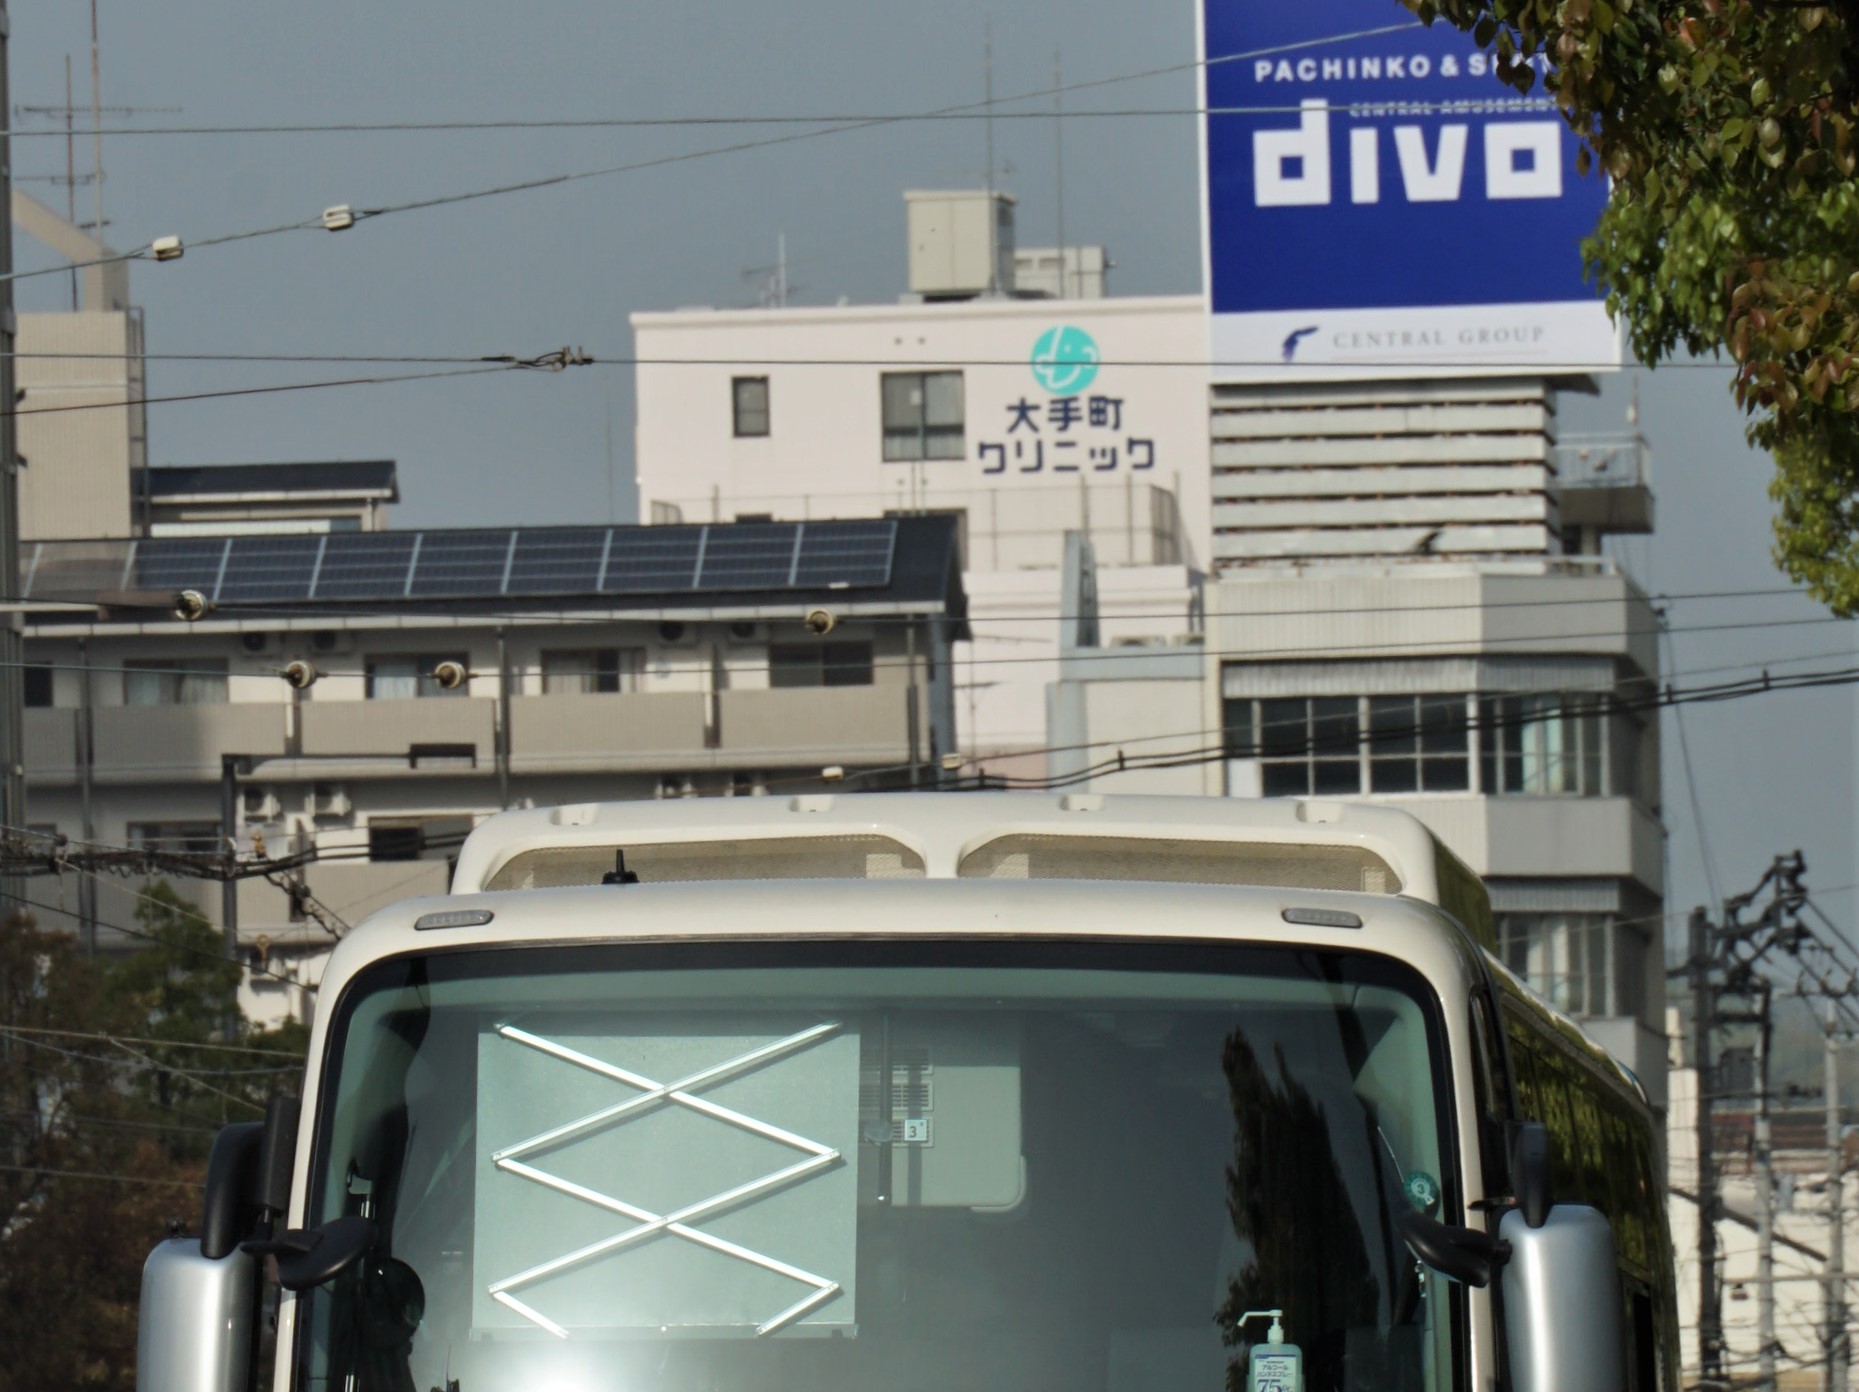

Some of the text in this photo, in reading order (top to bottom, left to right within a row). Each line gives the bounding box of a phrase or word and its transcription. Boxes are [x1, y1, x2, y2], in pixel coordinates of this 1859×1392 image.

[1255, 54, 1431, 82] PACHINKO
[1439, 54, 1459, 76] &
[1253, 99, 1562, 206] divo
[1333, 325, 1545, 349] CENTRAL GROUP
[1006, 396, 1124, 433] 大手町
[978, 437, 1155, 474] クリニック
